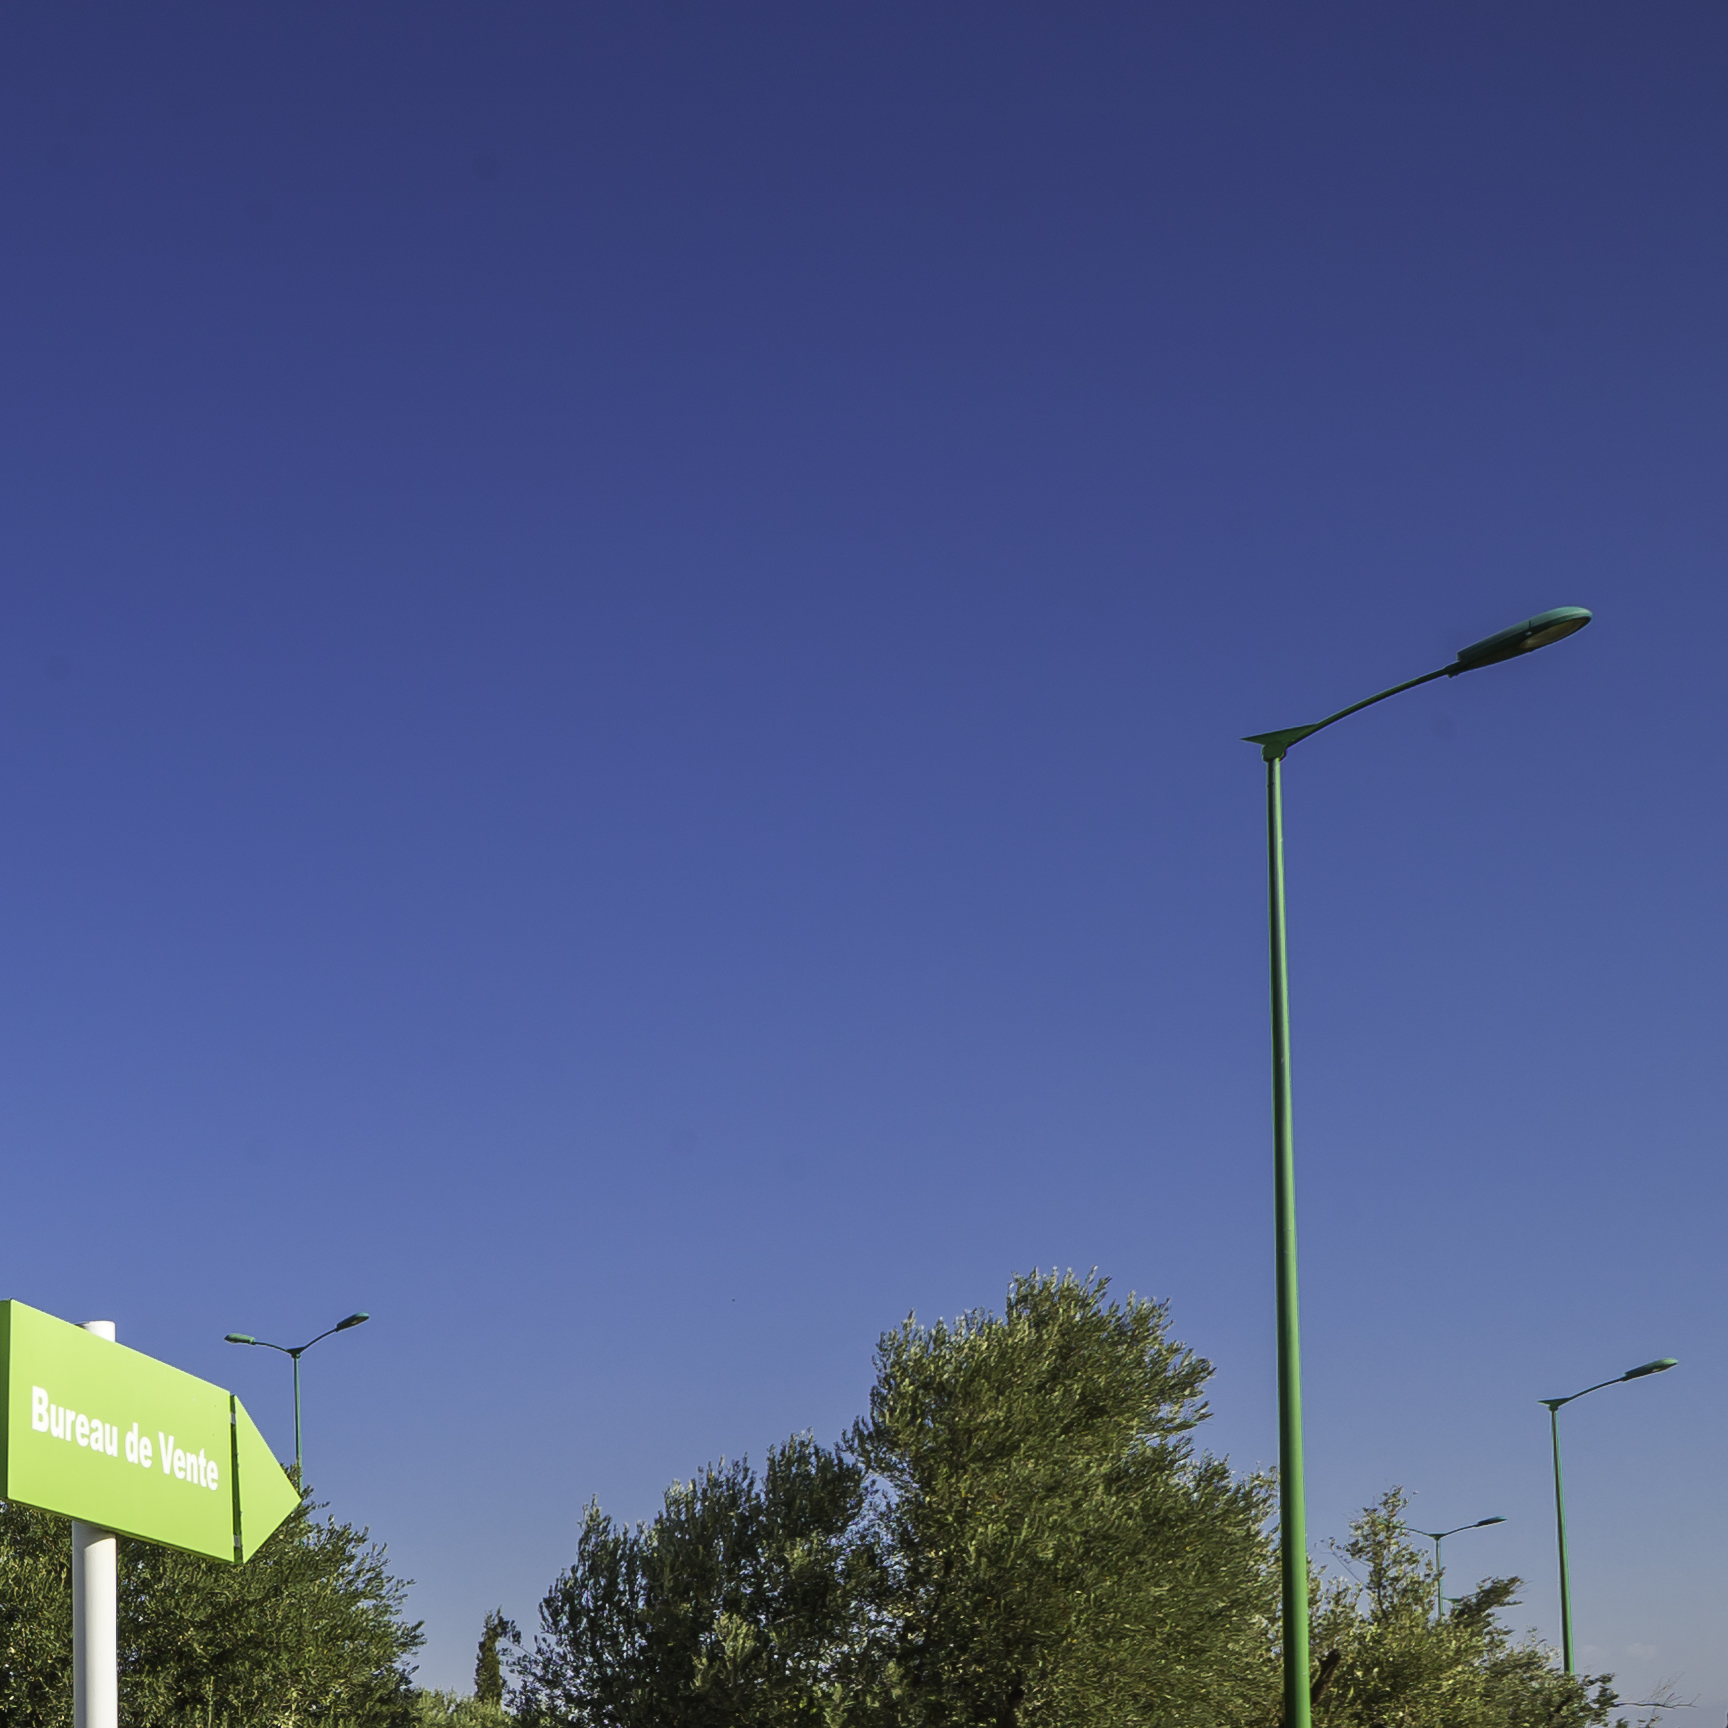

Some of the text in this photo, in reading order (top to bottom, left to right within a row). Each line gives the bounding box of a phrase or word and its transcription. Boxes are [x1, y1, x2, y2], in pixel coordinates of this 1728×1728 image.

[31, 1385, 219, 1491] Bureau de Vente
